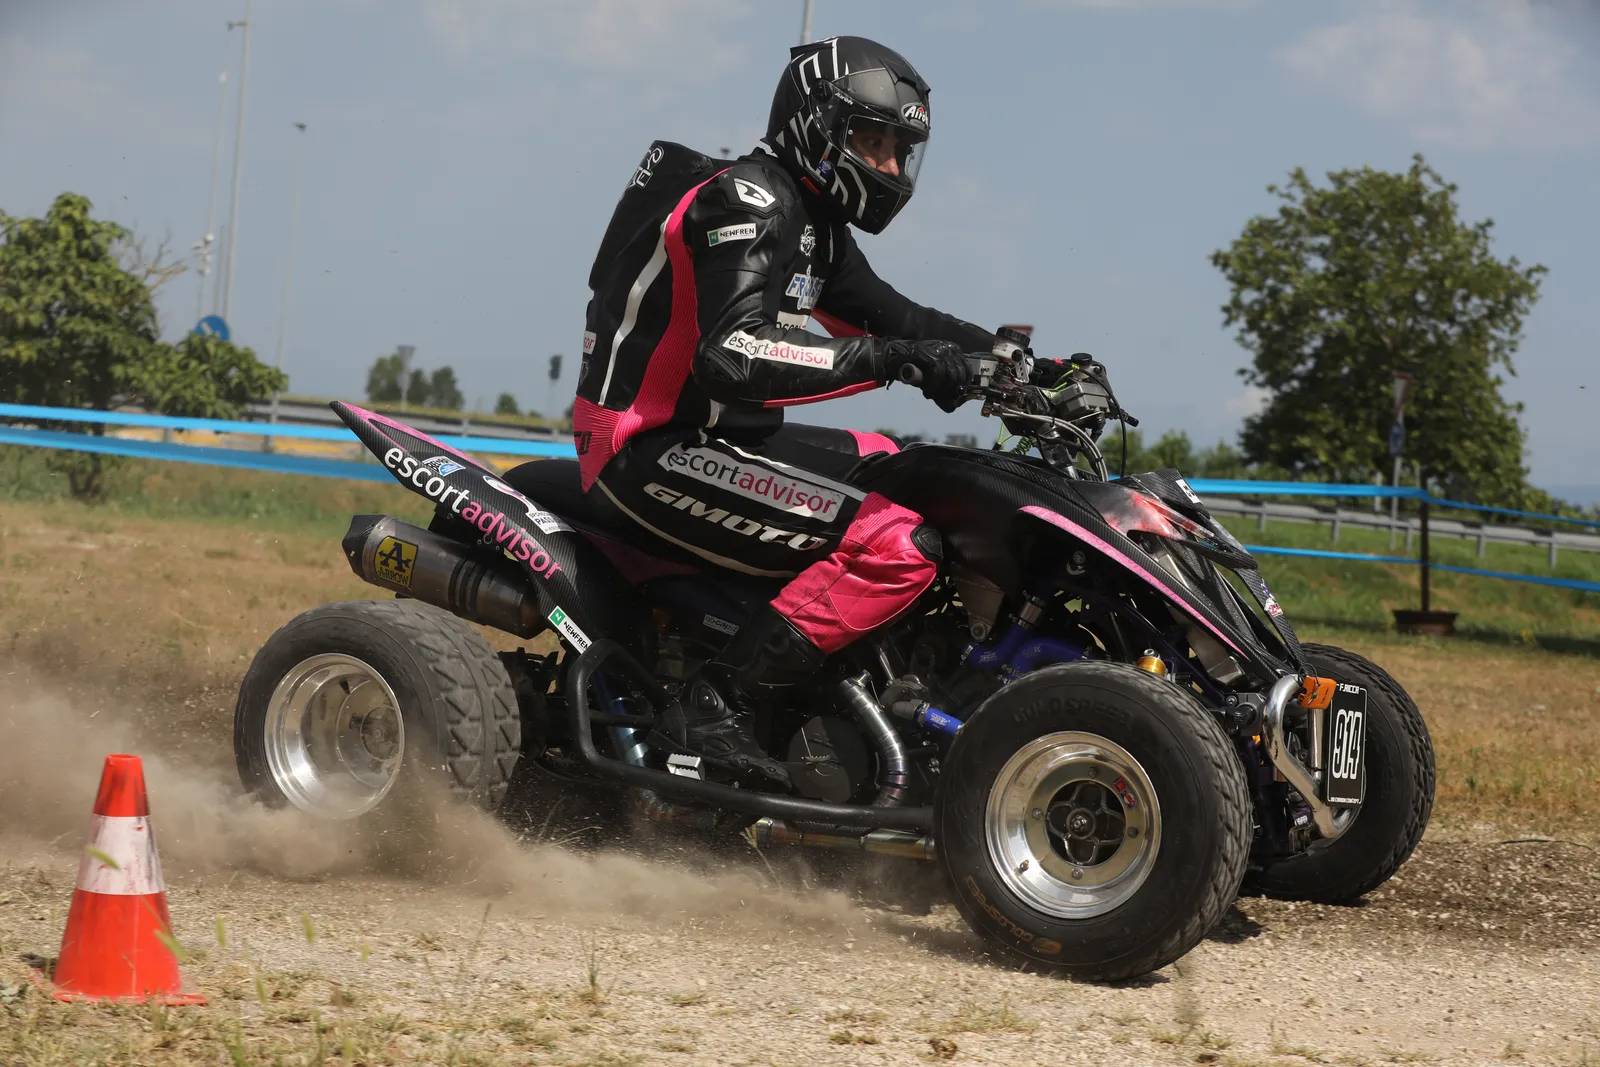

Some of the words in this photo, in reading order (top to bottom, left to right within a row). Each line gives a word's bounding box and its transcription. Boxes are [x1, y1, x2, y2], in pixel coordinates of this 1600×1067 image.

[719, 227, 755, 238] NEWFREN
[728, 335, 830, 366] escortadvisor
[667, 450, 837, 514] escortadvisor
[384, 447, 562, 580] escortadvisor
[643, 482, 828, 551] GIMOTO
[377, 566, 409, 585] ARROW
[563, 620, 589, 649] NEWFREN
[1332, 709, 1362, 779] 914
